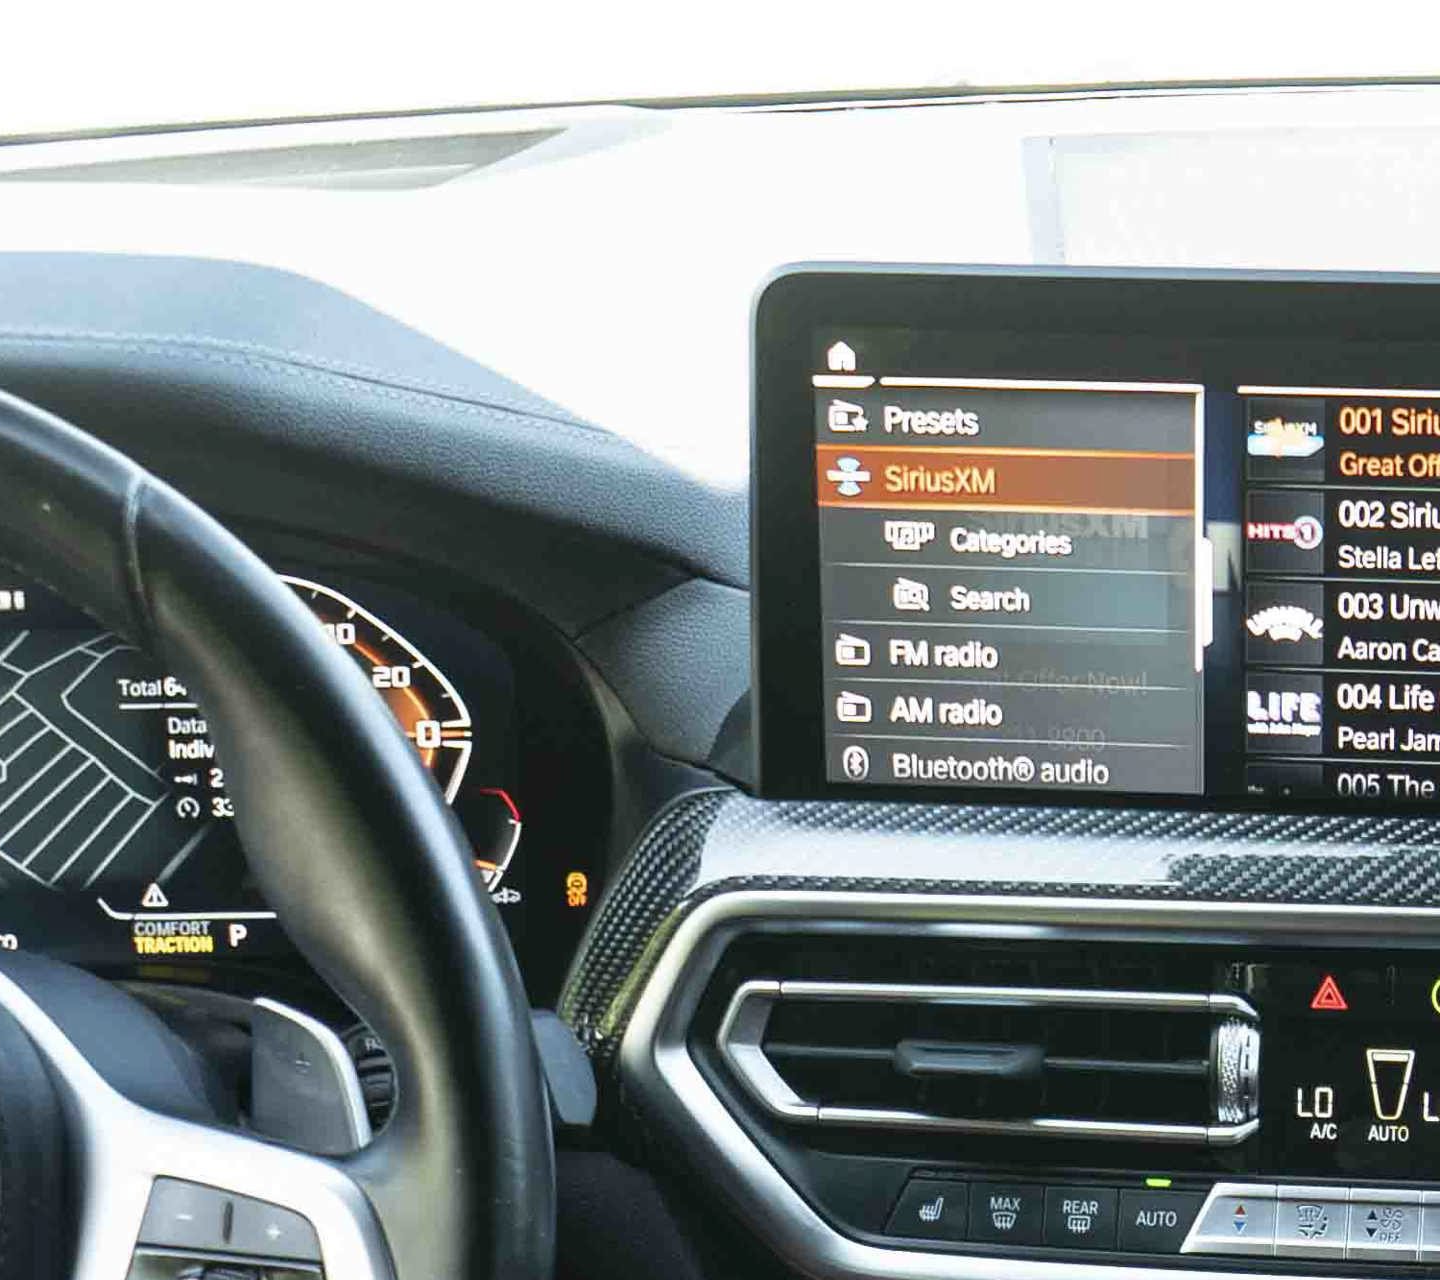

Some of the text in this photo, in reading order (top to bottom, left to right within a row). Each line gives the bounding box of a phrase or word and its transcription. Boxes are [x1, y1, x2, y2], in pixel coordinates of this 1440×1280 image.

[884, 406, 979, 436] Presets
[1340, 408, 1383, 434] 001
[1340, 452, 1403, 477] Great
[885, 465, 995, 494] SiriusXM
[1339, 501, 1384, 528] 002
[951, 529, 1072, 559] Categories
[1338, 545, 1401, 571] Stella
[951, 587, 1029, 611] Search
[1338, 593, 1383, 620] 003
[889, 642, 998, 668] FM radio
[1338, 636, 1406, 661] Aaron
[117, 679, 161, 696] Total
[372, 666, 410, 688] 20
[1247, 690, 1321, 722] LIFE
[1337, 684, 1383, 710] 004
[1388, 684, 1434, 712] Life
[891, 698, 1002, 727] AM radio
[168, 717, 207, 734] Data
[416, 720, 441, 748] 0
[1338, 728, 1395, 752] Pearl
[893, 753, 1110, 786] Bluetooth® audio
[1337, 774, 1383, 798] 005
[1387, 774, 1435, 799] The
[134, 921, 210, 936] COMFORT
[229, 924, 247, 947] P
[134, 937, 212, 954] TRACTION
[1297, 1087, 1333, 1118] LO
[1310, 1123, 1338, 1140] A/C
[1368, 1125, 1409, 1142] AUTO
[989, 1197, 1021, 1211] MAX
[1063, 1200, 1098, 1215] REAR
[1136, 1210, 1177, 1227] AUTO
